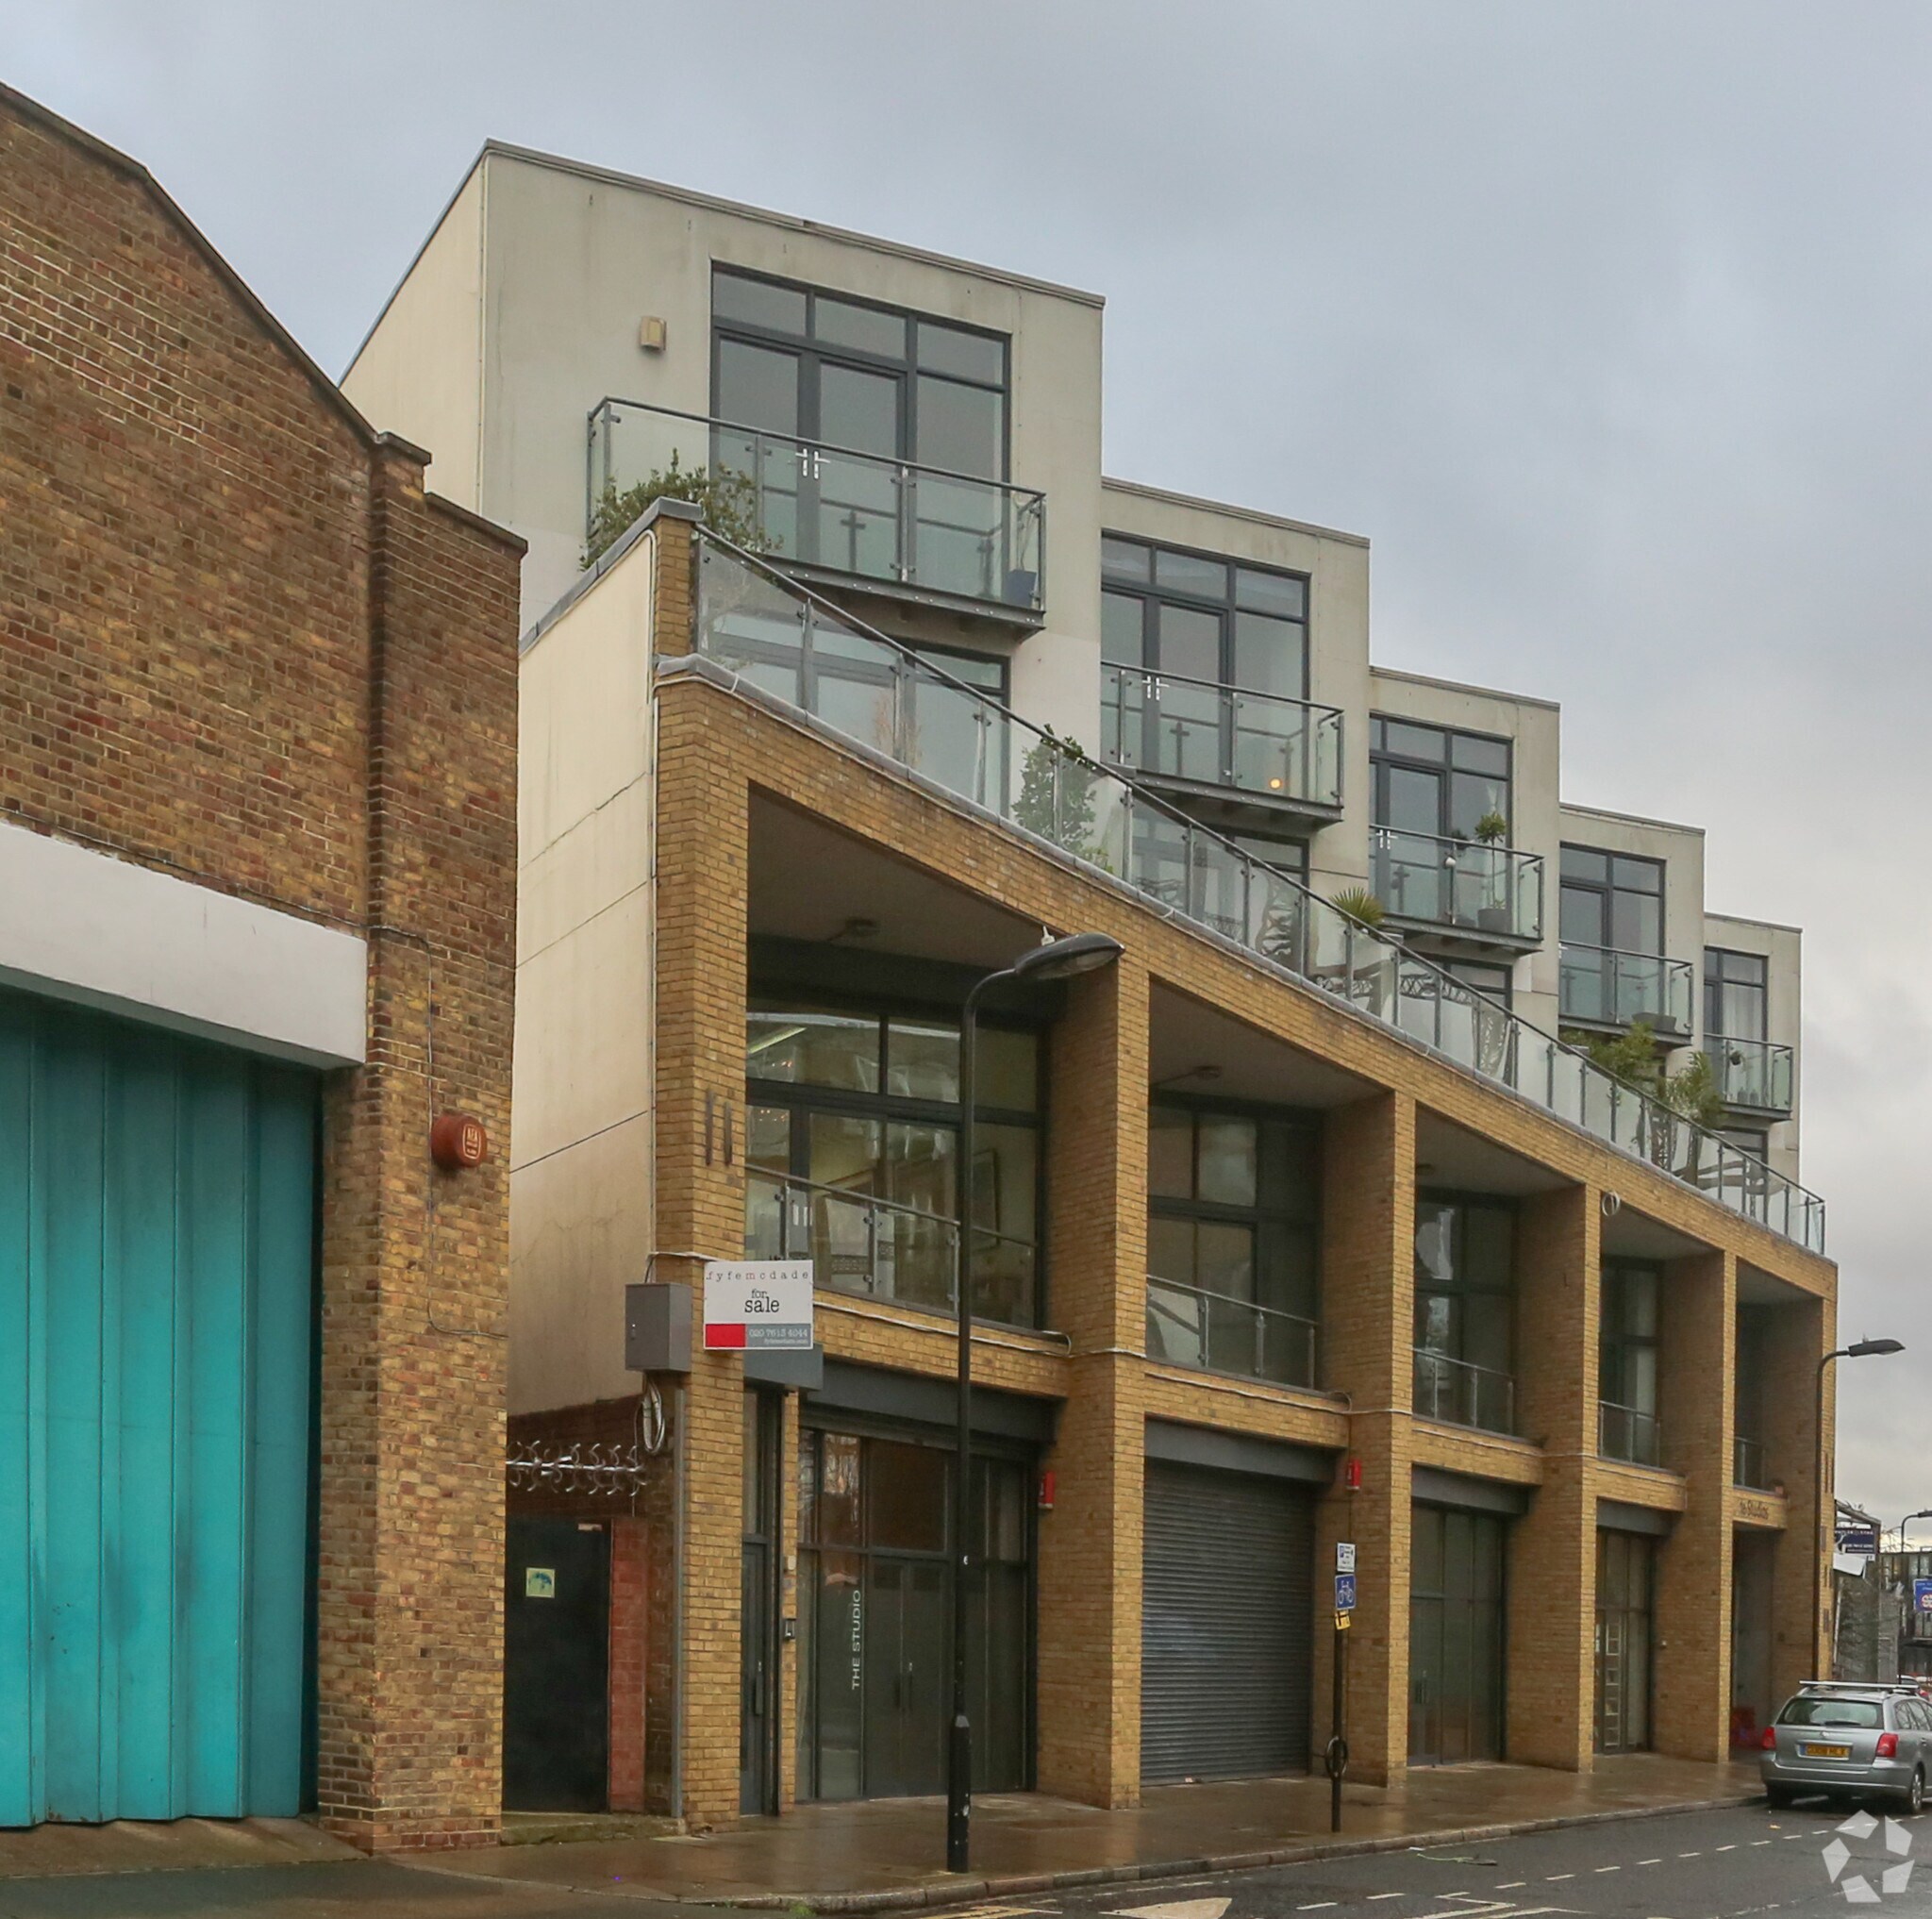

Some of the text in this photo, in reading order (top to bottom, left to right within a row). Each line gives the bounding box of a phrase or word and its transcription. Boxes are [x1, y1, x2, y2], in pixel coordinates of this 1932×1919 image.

[751, 1288, 768, 1299] for
[744, 1296, 780, 1313] sale
[852, 1590, 861, 1690] THE STUDIO
